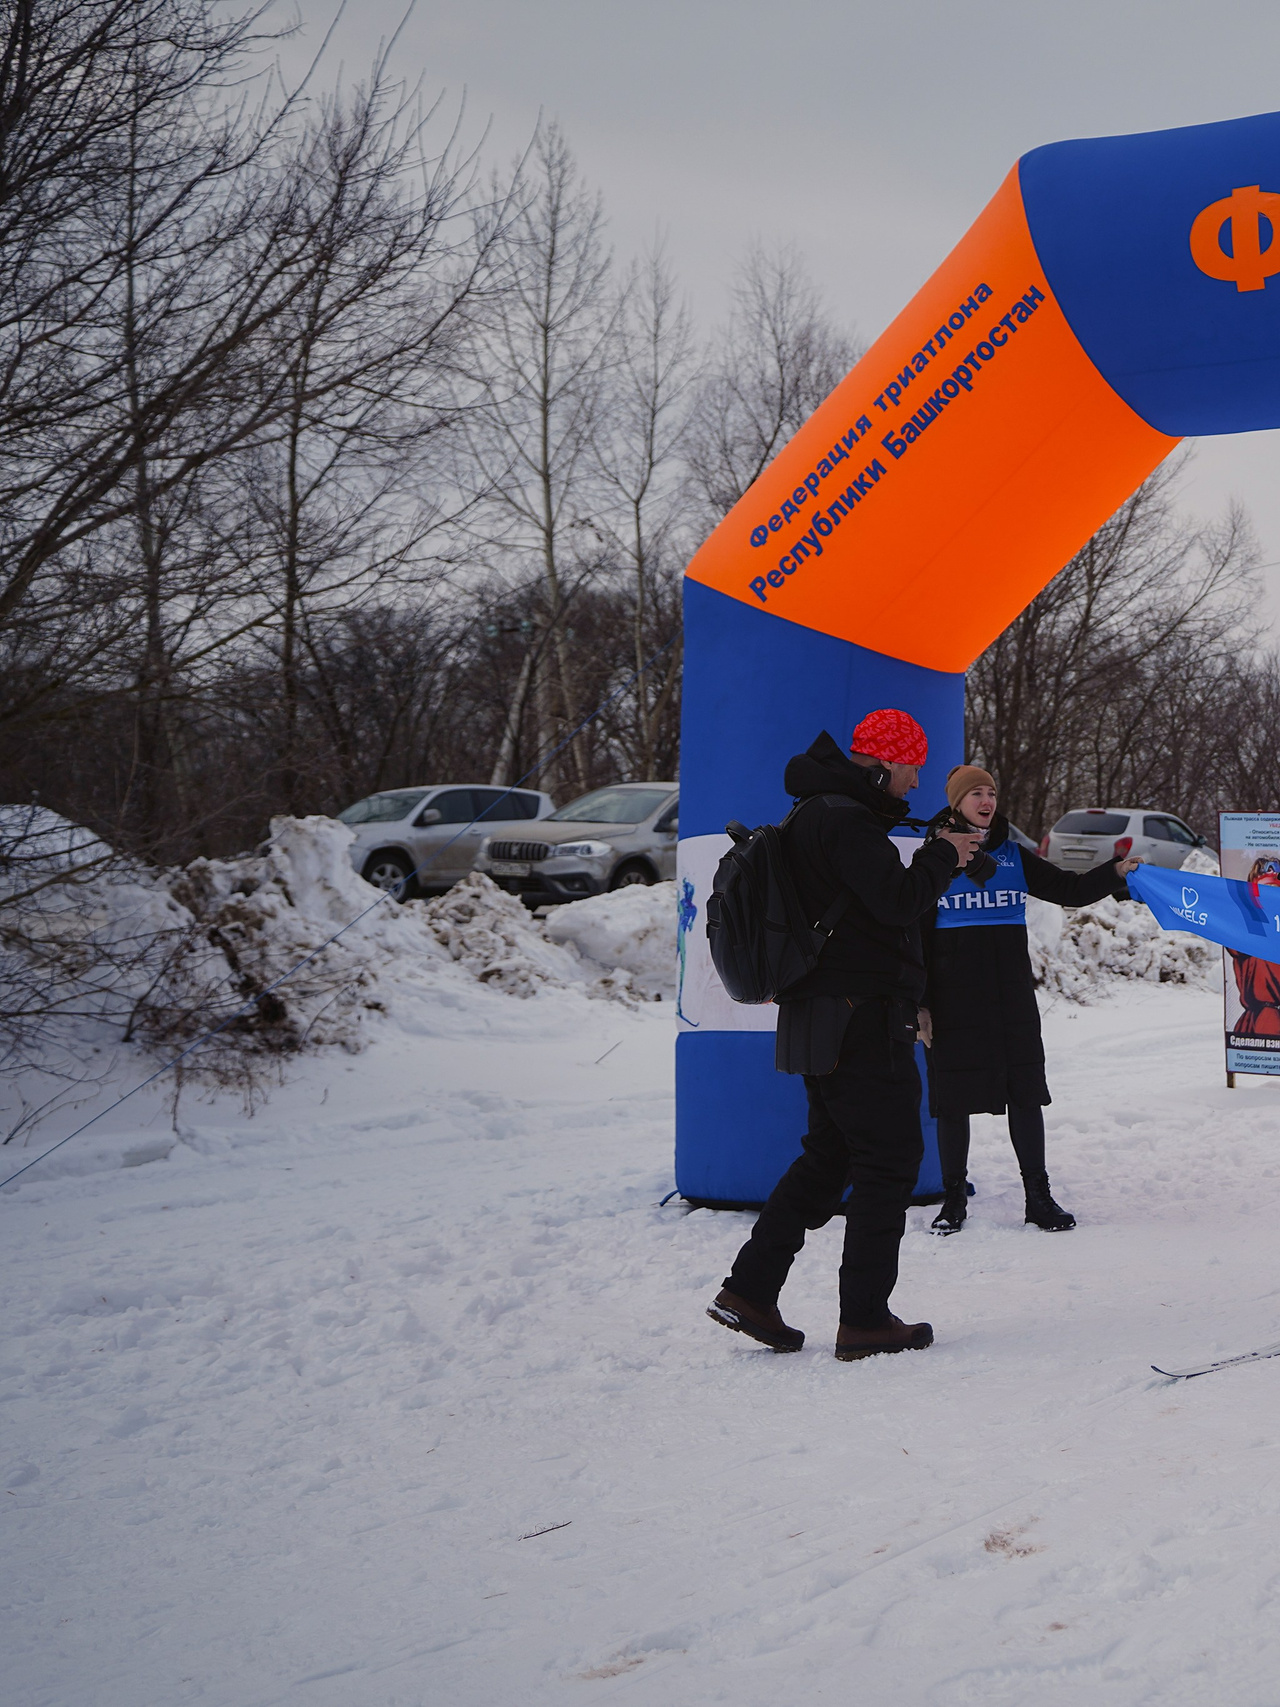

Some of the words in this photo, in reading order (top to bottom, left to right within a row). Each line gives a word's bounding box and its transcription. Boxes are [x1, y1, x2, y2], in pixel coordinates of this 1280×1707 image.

[748, 458, 888, 603] Республики
[880, 285, 1046, 460] Башкортостан
[750, 414, 873, 548] Федерация
[873, 282, 994, 413] триатлона
[1230, 1035, 1265, 1047] Сделали
